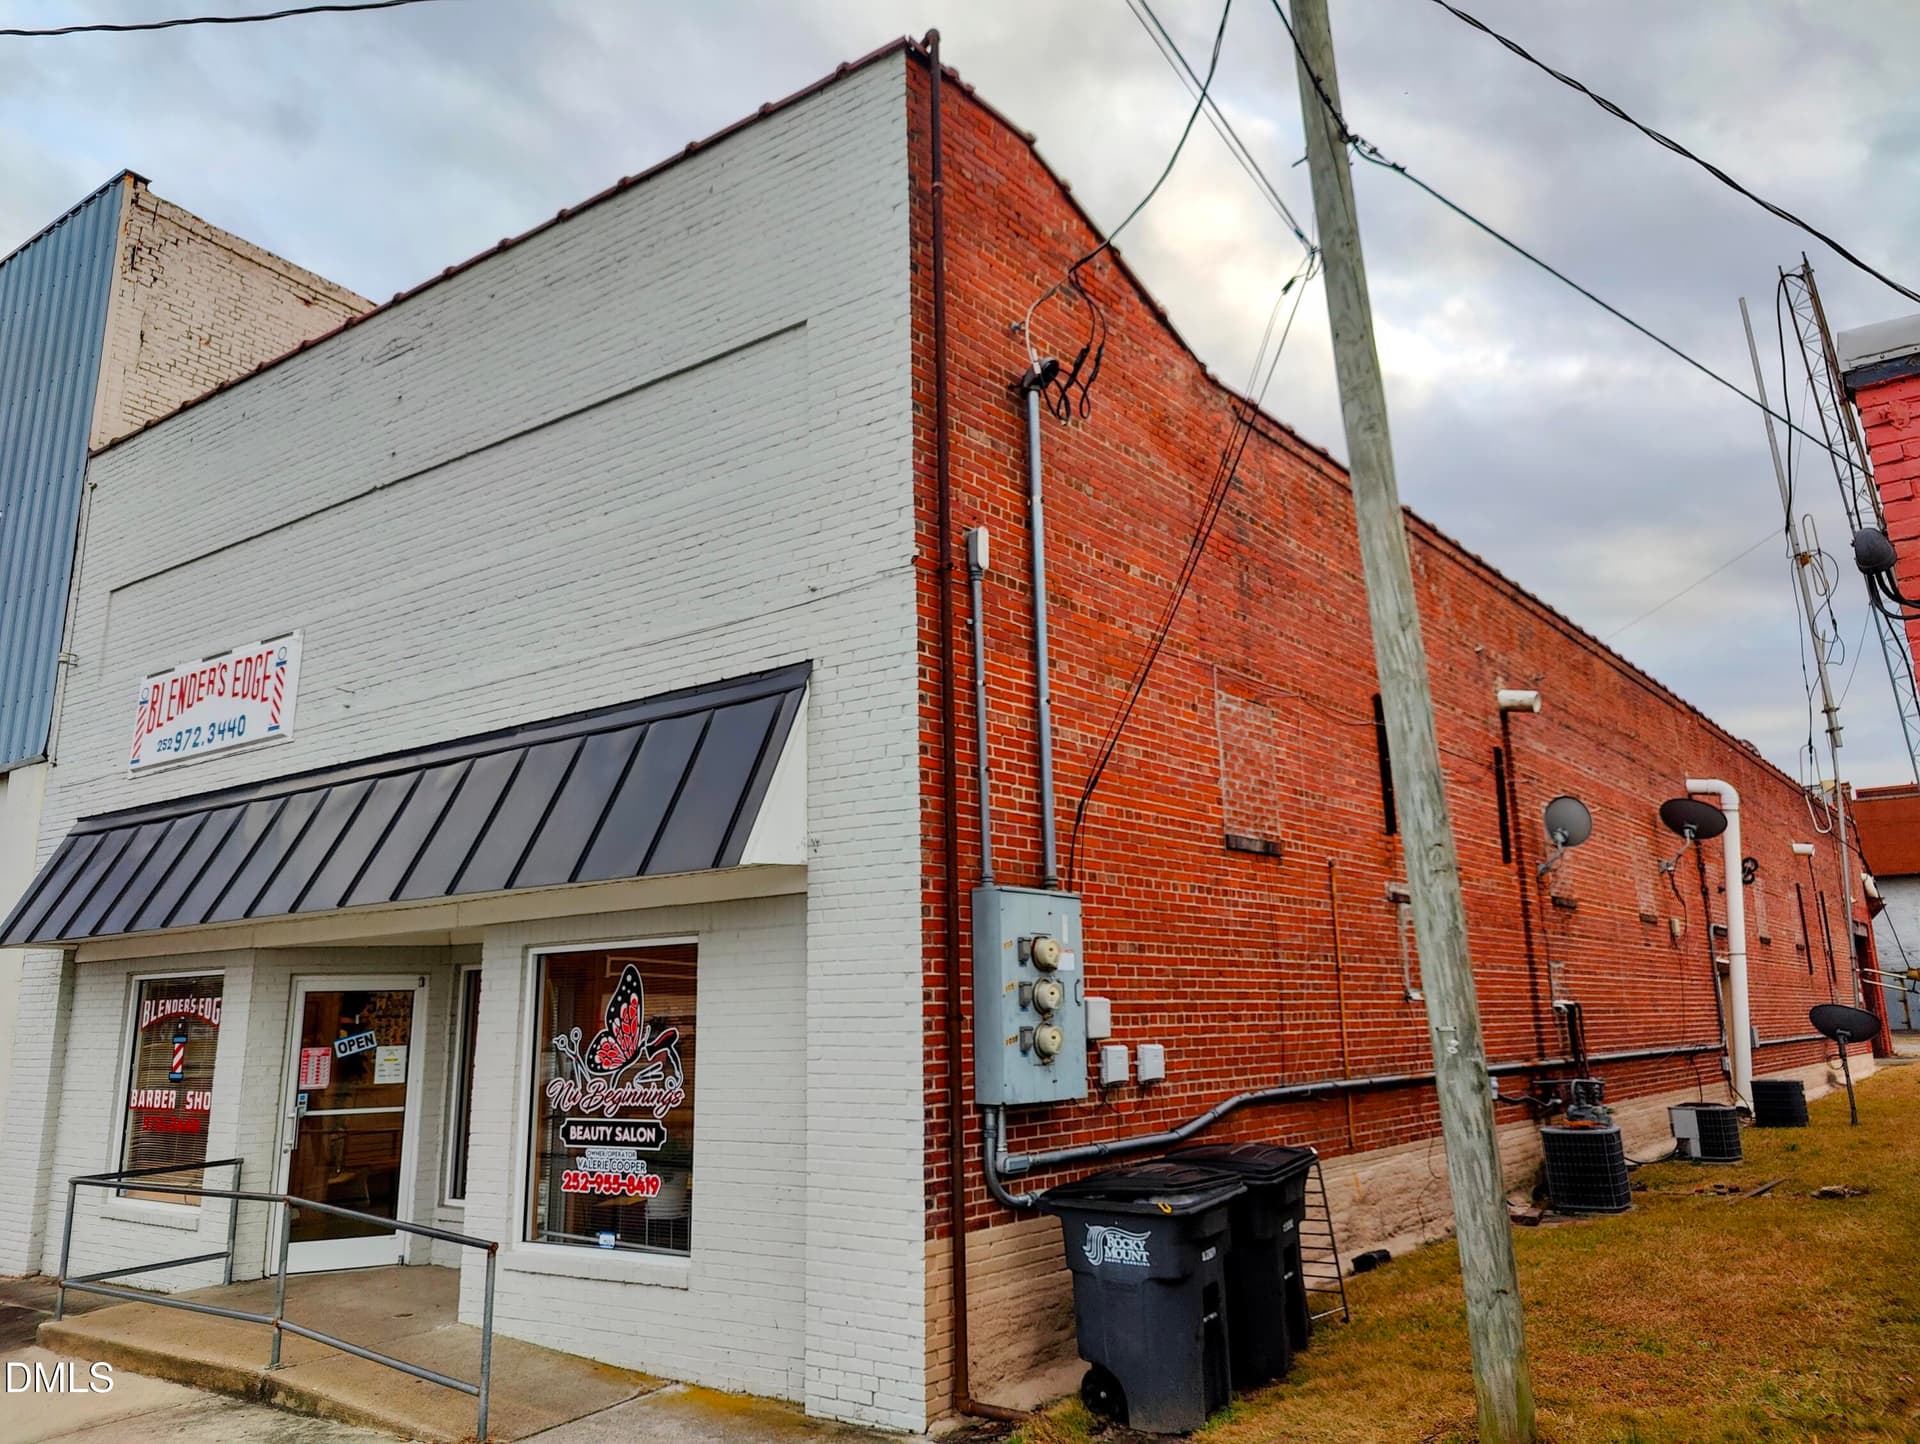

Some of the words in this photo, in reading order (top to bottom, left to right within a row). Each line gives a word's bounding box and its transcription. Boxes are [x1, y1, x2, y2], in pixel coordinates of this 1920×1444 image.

[146, 662, 228, 734] BLENDER'S
[231, 650, 274, 703] EDGE
[156, 737, 173, 752] 252
[173, 714, 247, 752] 972.3440
[142, 994, 197, 1029] BLENDER'S
[337, 1036, 375, 1055] OPEN
[130, 1089, 177, 1109] BARBER
[546, 1077, 582, 1112] Nu
[579, 1077, 685, 1119] Beginnings
[569, 1125, 613, 1141] BEAUTY
[614, 1126, 656, 1143] SALON
[577, 1158, 609, 1171] VALERIE
[611, 1160, 646, 1173] COOPER
[1106, 1236, 1146, 1251] ROCKY
[1104, 1246, 1150, 1262] MOUNT
